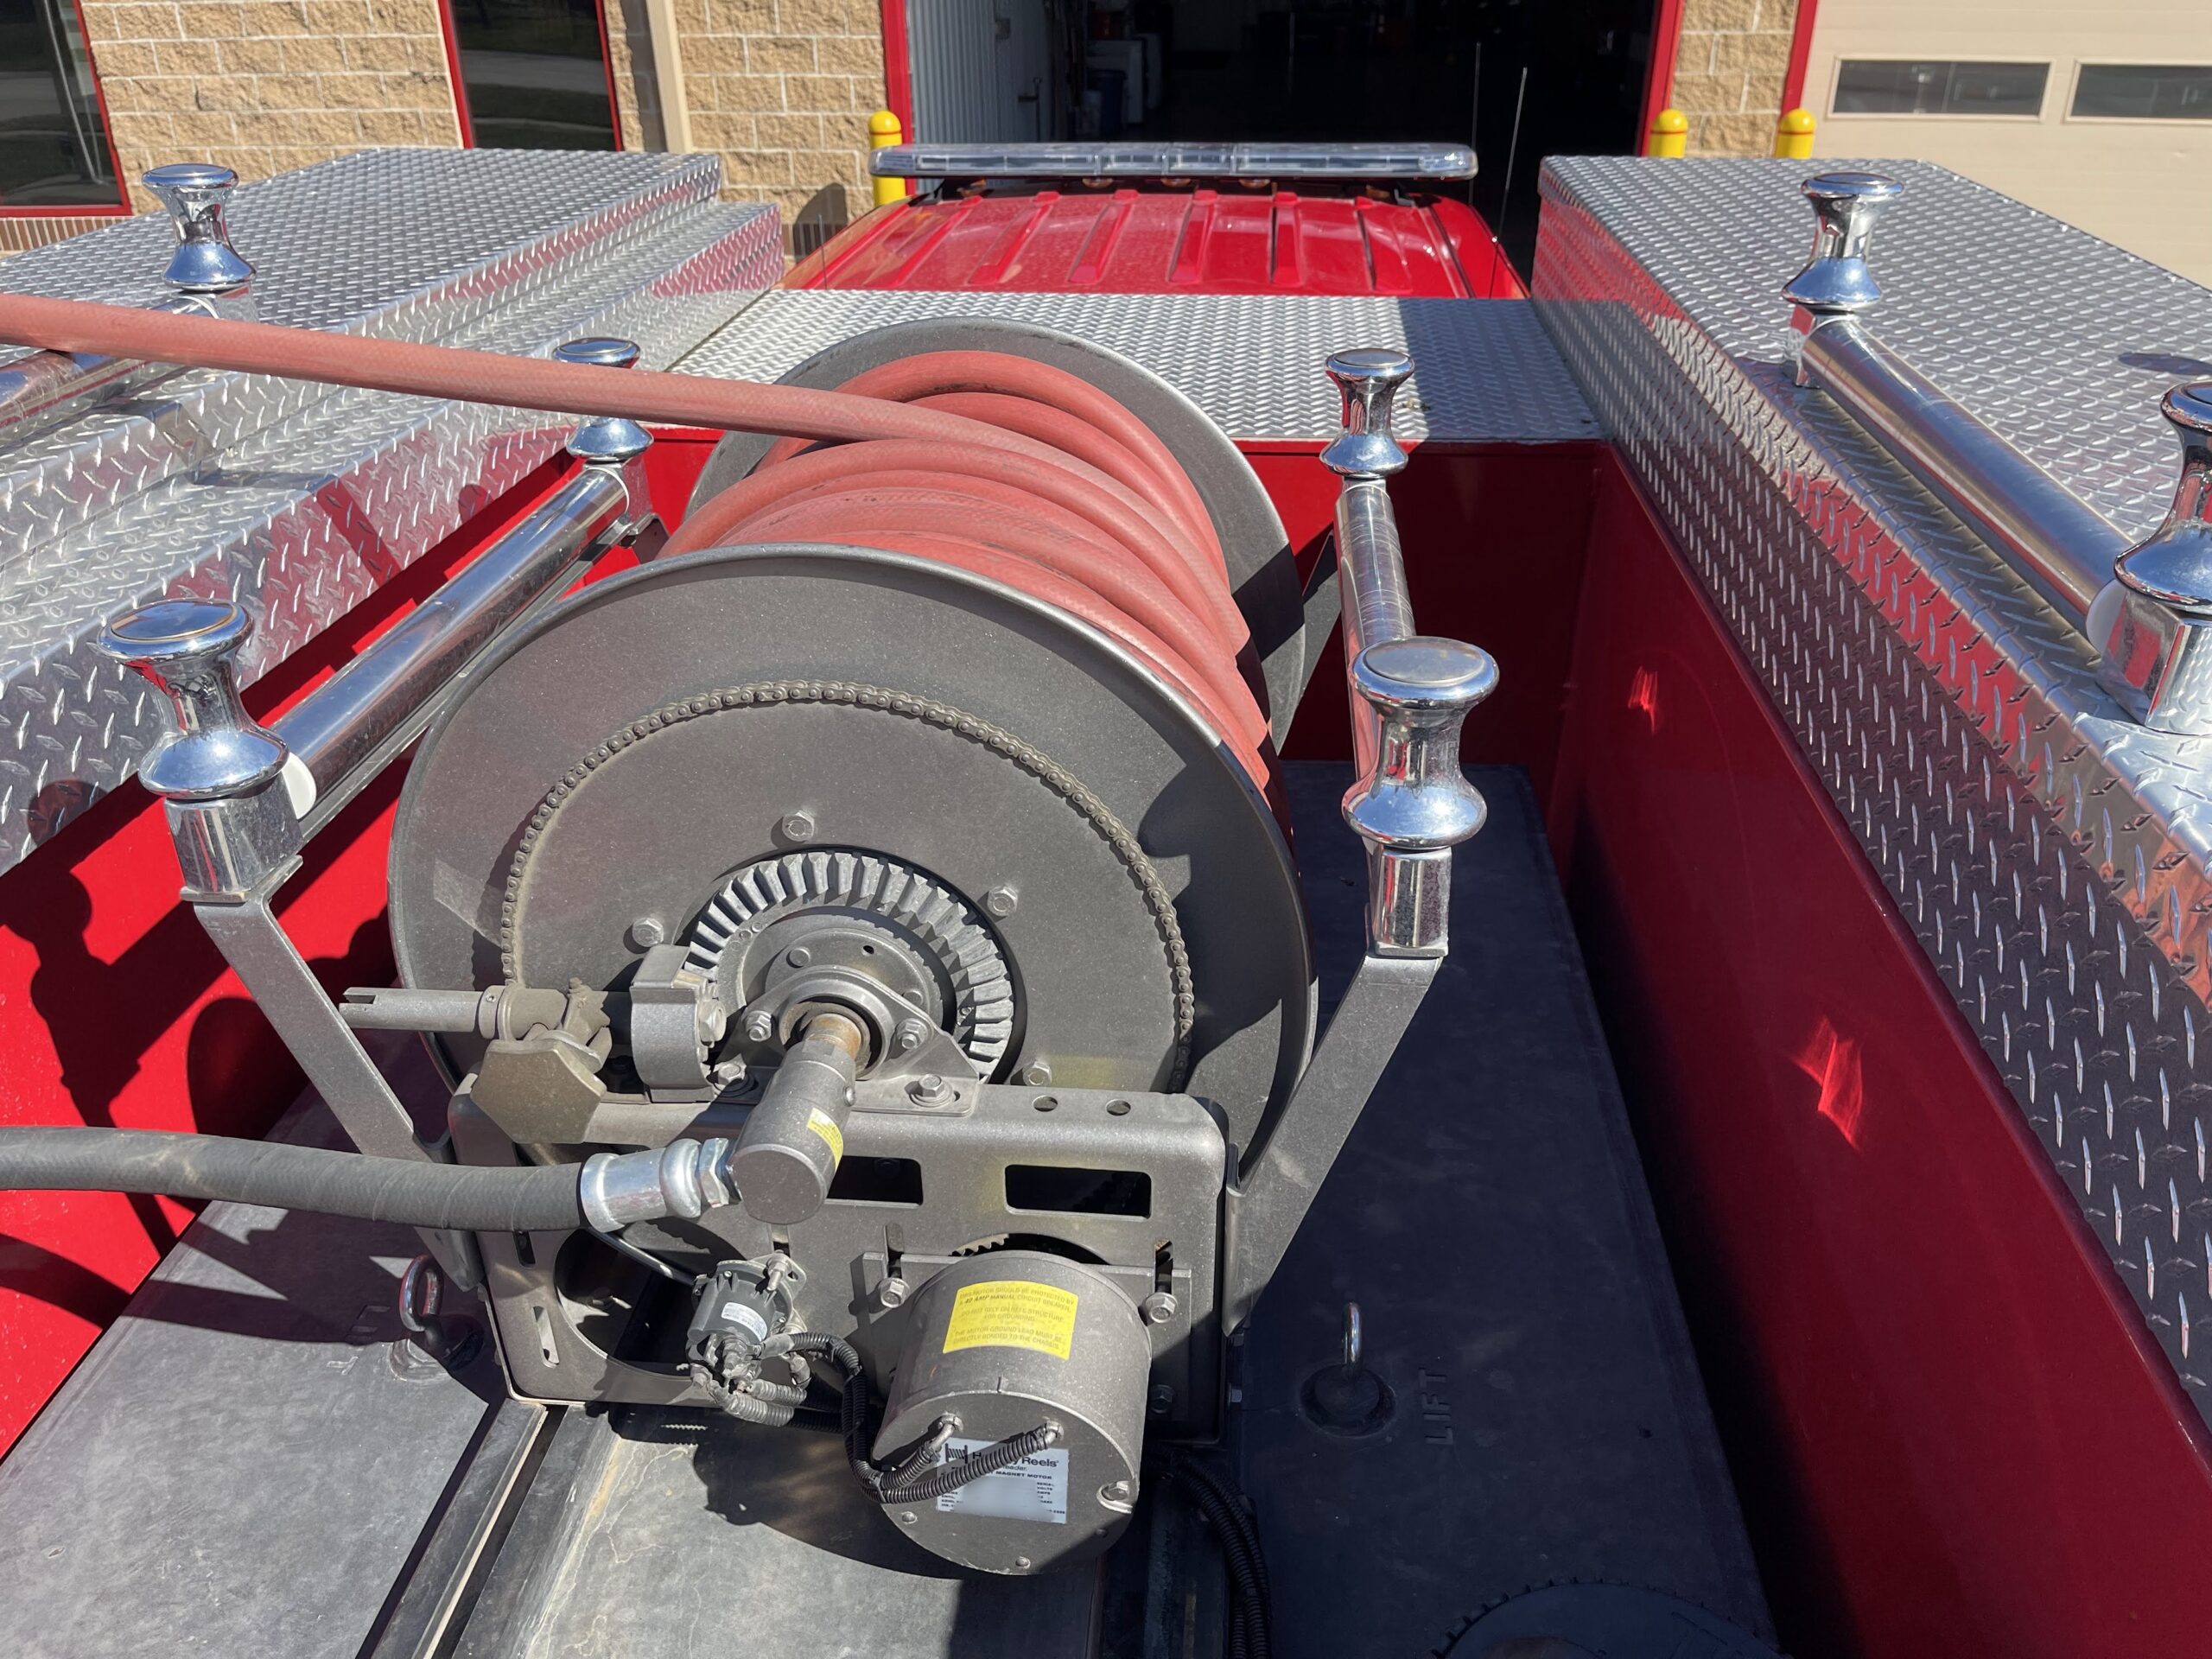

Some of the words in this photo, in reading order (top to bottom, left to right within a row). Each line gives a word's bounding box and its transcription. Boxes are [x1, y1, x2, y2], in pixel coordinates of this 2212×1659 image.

[1031, 1288, 1065, 1302] PROTECTED
[1028, 1308, 1064, 1321] STRUCTURE
[1418, 1368, 1453, 1445] LIFT
